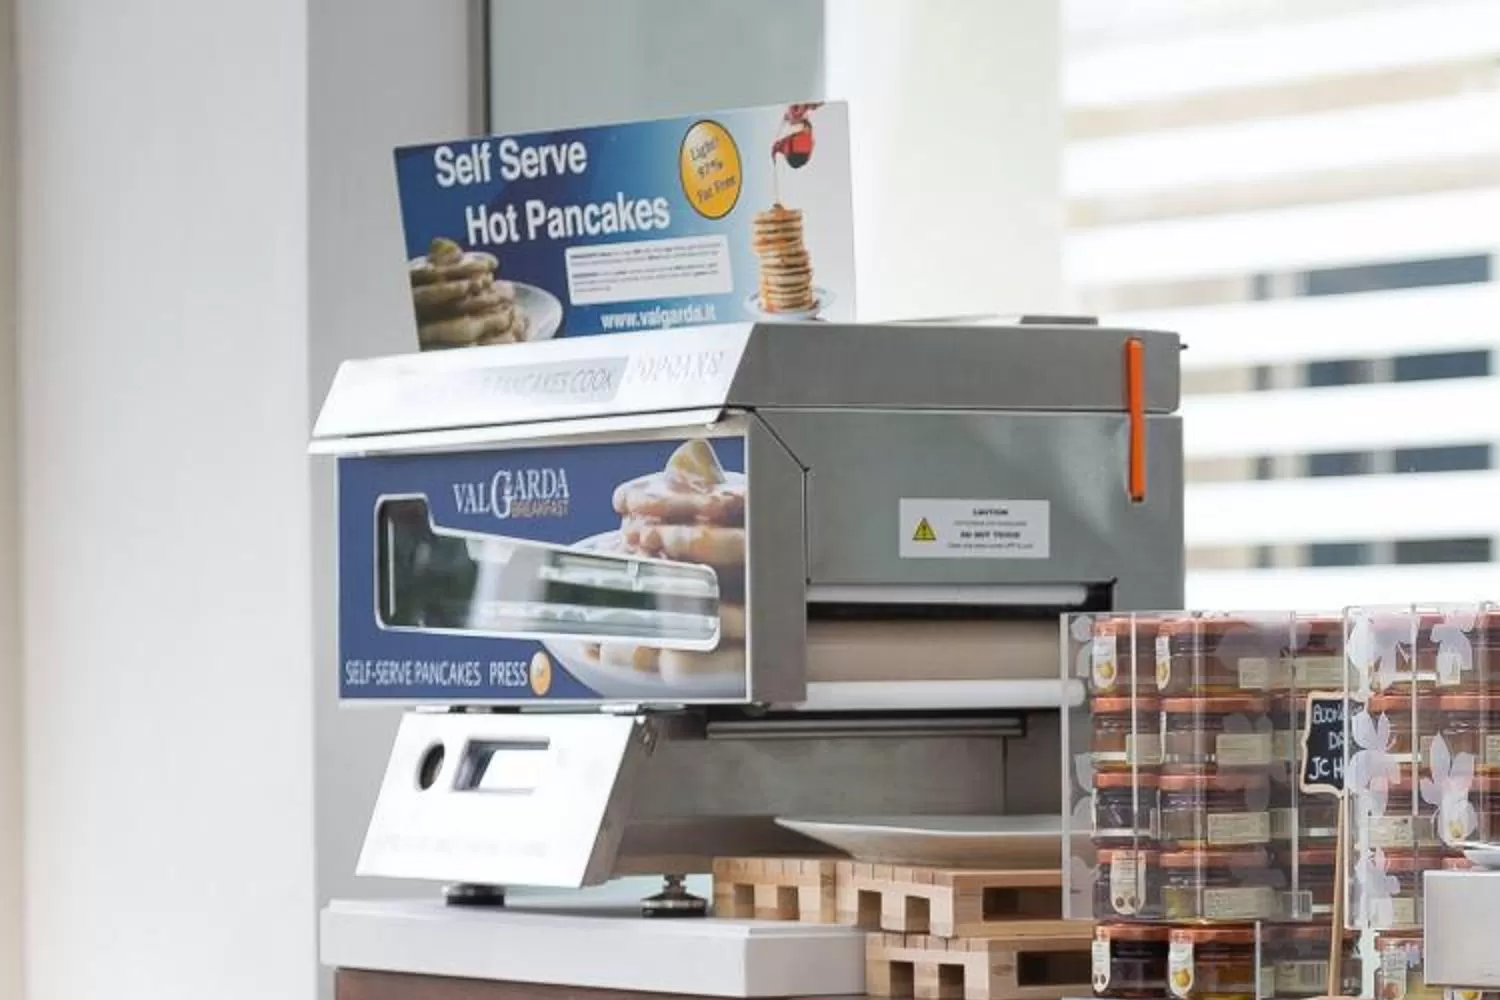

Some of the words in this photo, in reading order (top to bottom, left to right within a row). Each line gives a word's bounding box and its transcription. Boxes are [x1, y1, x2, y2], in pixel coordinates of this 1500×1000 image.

[434, 141, 492, 187] Self
[498, 138, 588, 181] Serve
[465, 204, 520, 246] Hot
[525, 191, 670, 240] Pancakes
[601, 304, 718, 331] www.valgarda.it
[452, 467, 570, 519] VALGARDA
[345, 660, 412, 686] SELF-SERVE
[414, 660, 482, 687] PANCAKES
[489, 661, 528, 687] PRESS
